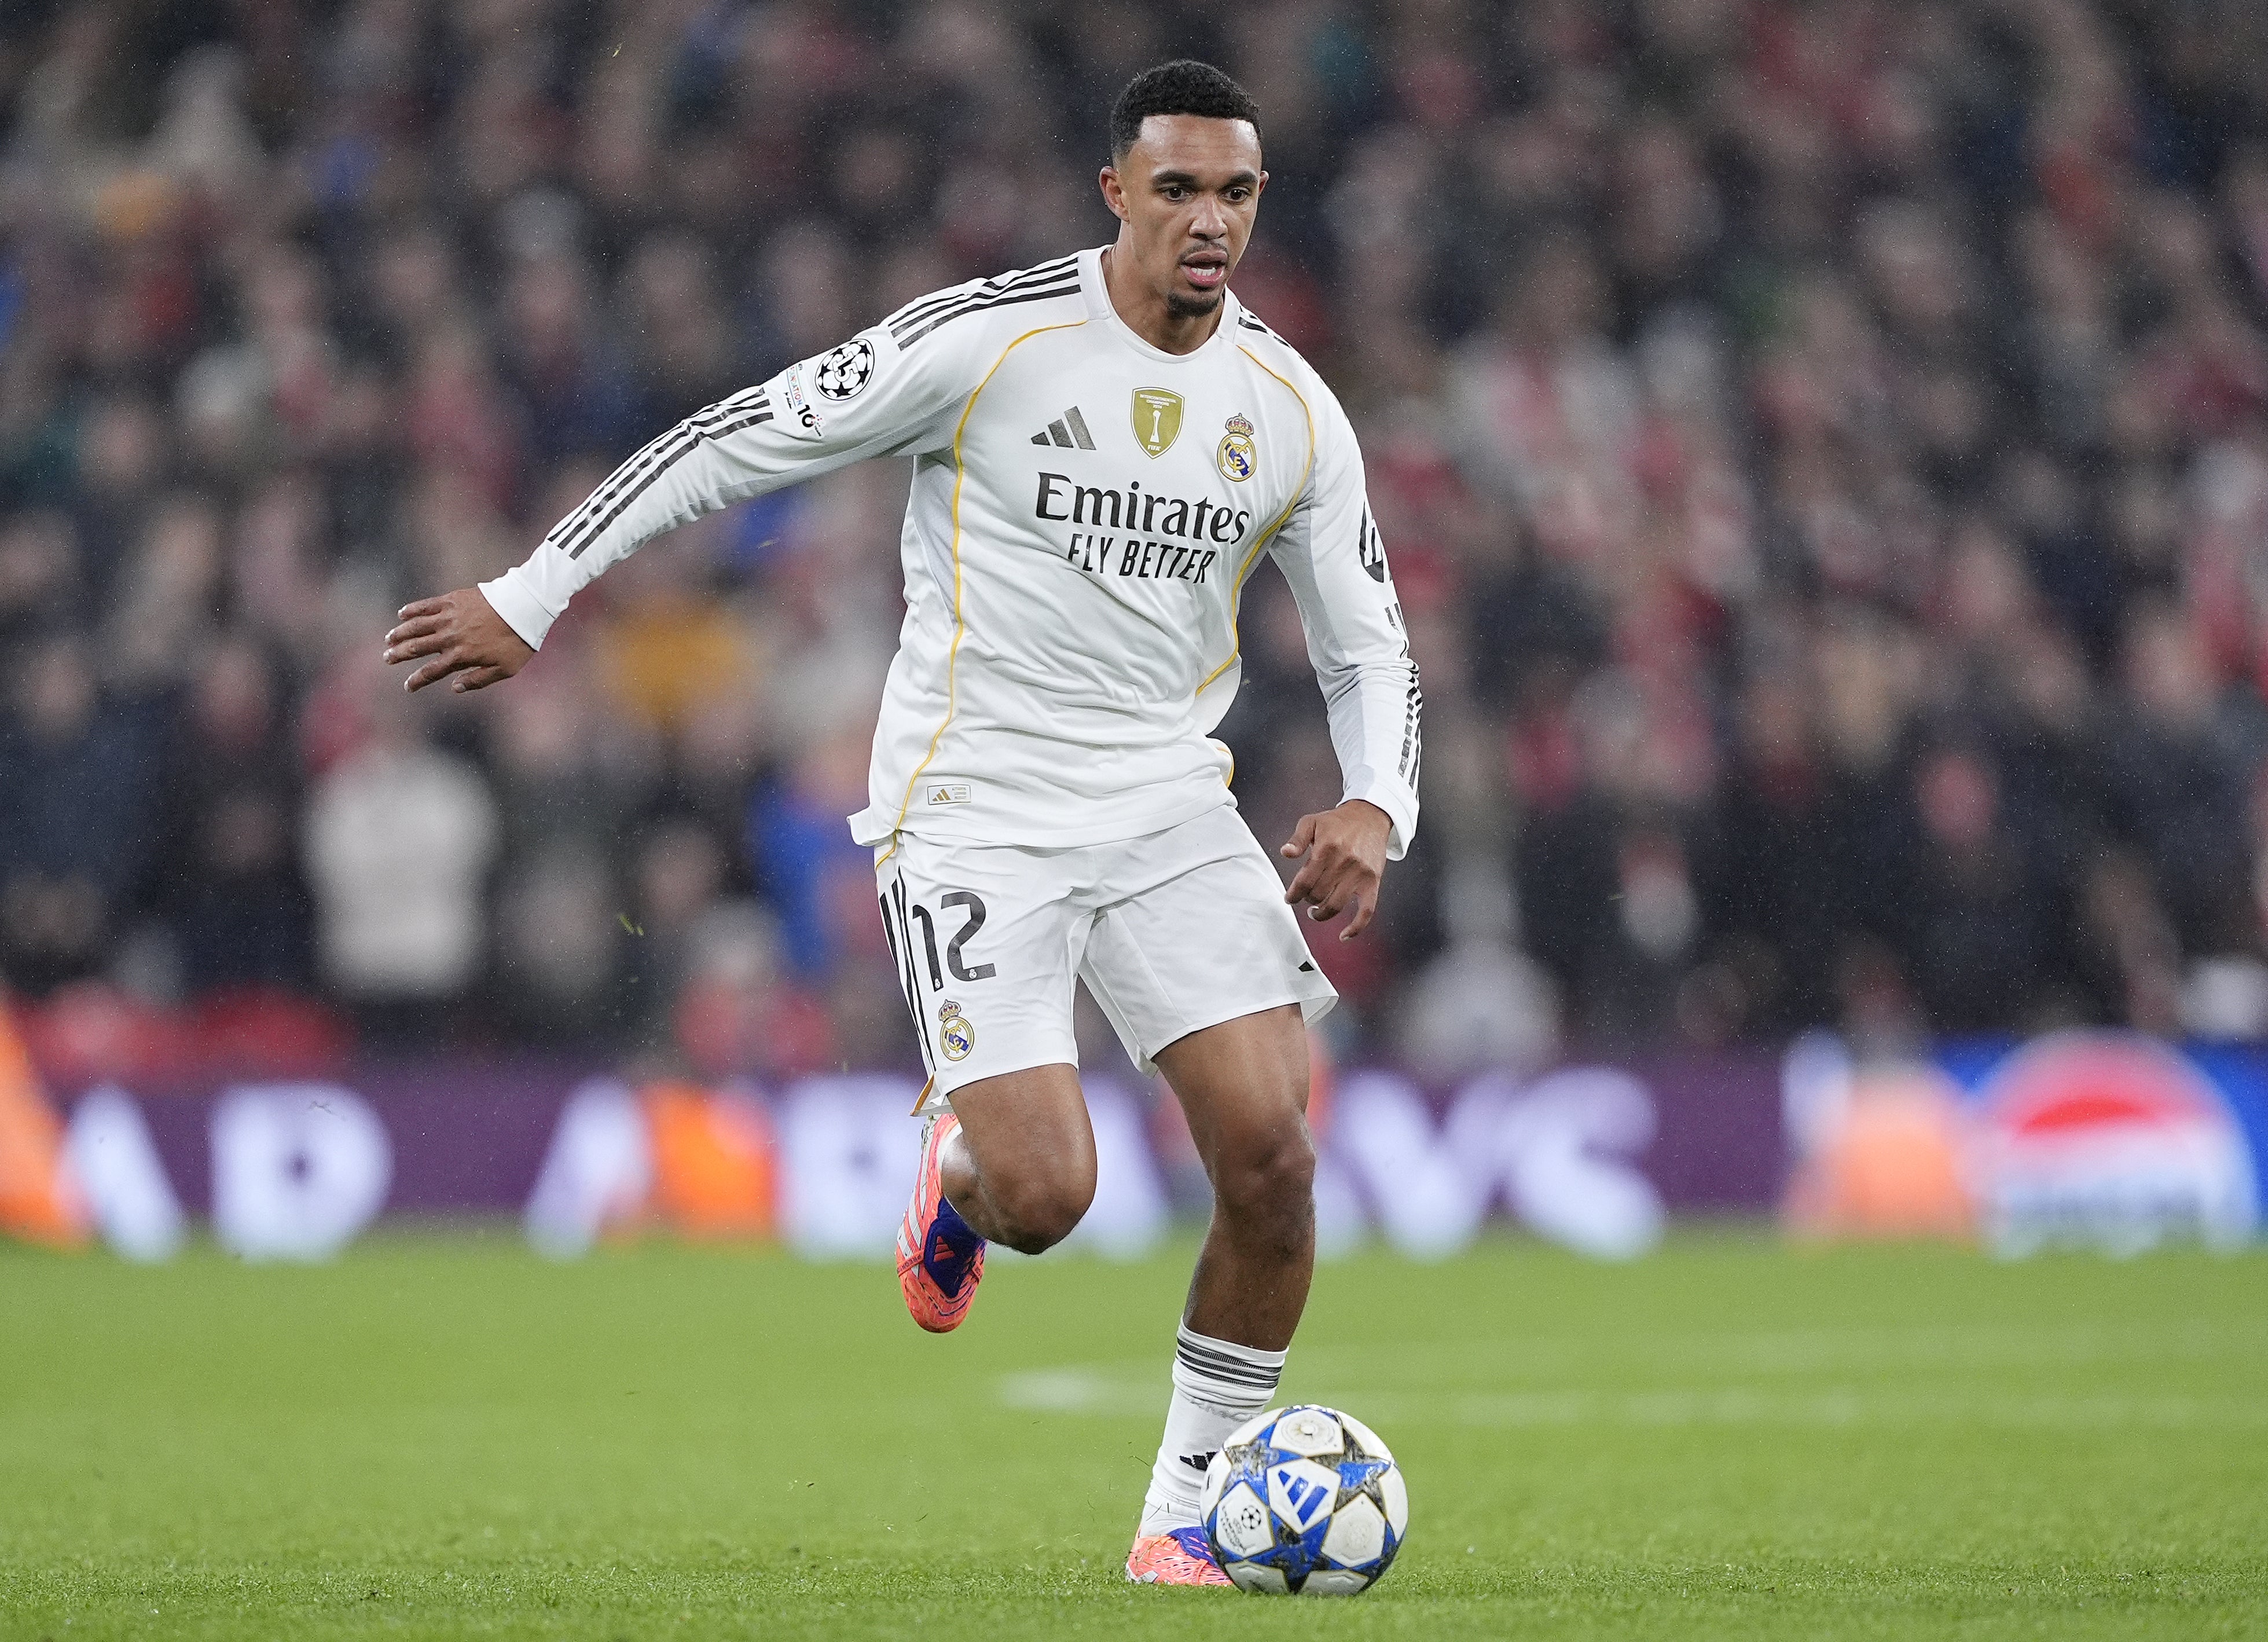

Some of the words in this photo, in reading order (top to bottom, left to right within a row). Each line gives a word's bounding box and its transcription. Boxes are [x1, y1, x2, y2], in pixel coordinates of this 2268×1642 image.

[1036, 471, 1249, 545] Emirates
[1068, 533, 1114, 574] FLY
[1119, 540, 1216, 584] BETTER
[912, 891, 997, 992] 12
